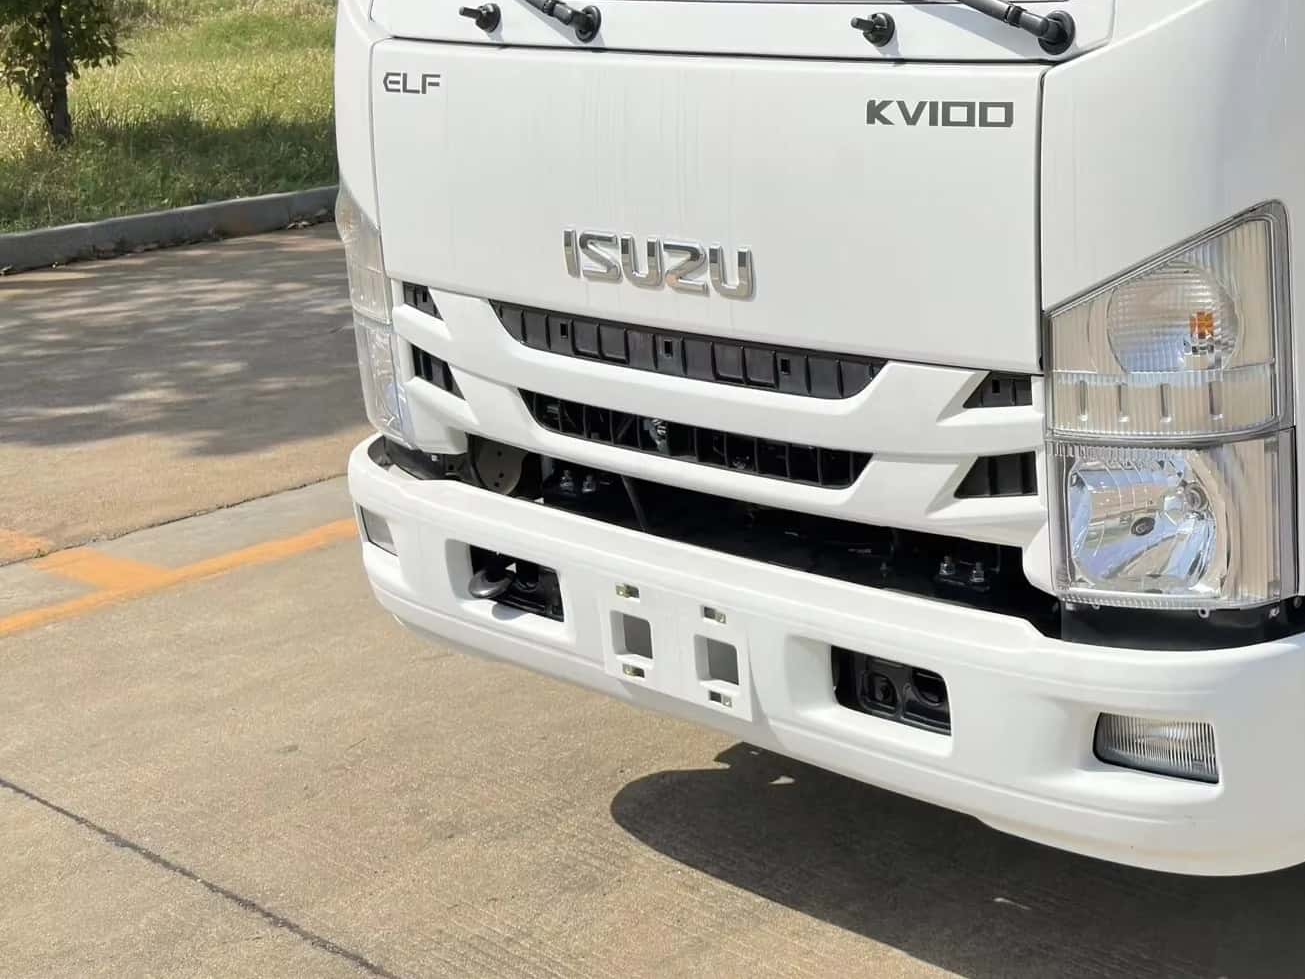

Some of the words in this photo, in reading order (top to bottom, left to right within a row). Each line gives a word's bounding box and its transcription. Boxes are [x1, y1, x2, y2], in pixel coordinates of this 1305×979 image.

[383, 72, 441, 94] ELF
[866, 100, 1014, 128] KV100
[563, 228, 755, 302] ISUZU
